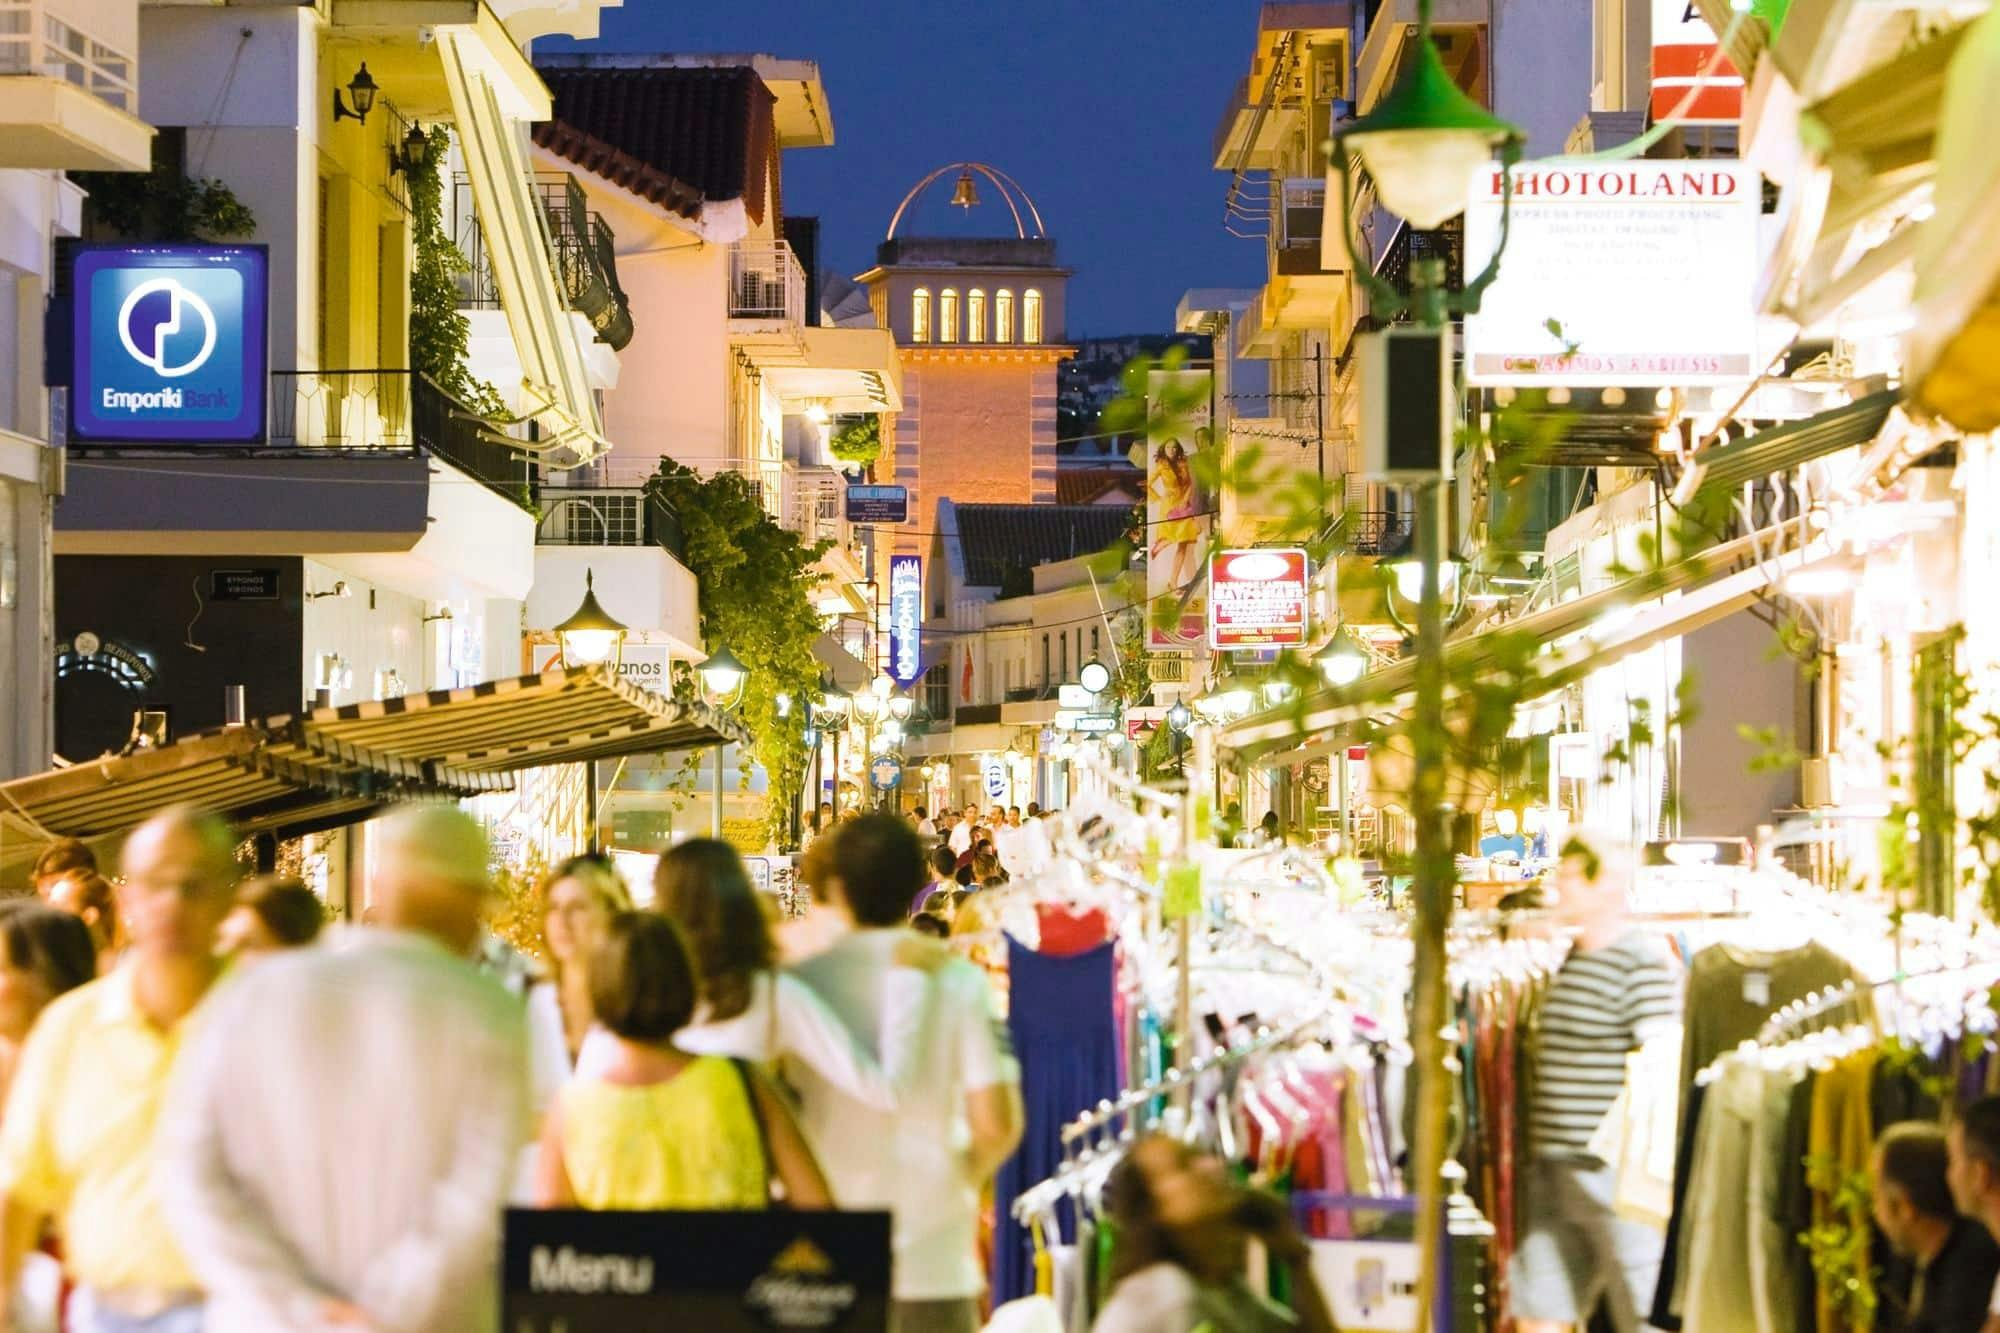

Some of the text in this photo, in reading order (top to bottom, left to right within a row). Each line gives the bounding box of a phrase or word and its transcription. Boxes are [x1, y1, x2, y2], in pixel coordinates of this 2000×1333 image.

[1508, 208, 1570, 220] XPRESS
[103, 387, 228, 413] Emporiki Bank
[530, 1245, 655, 1294] Menu
